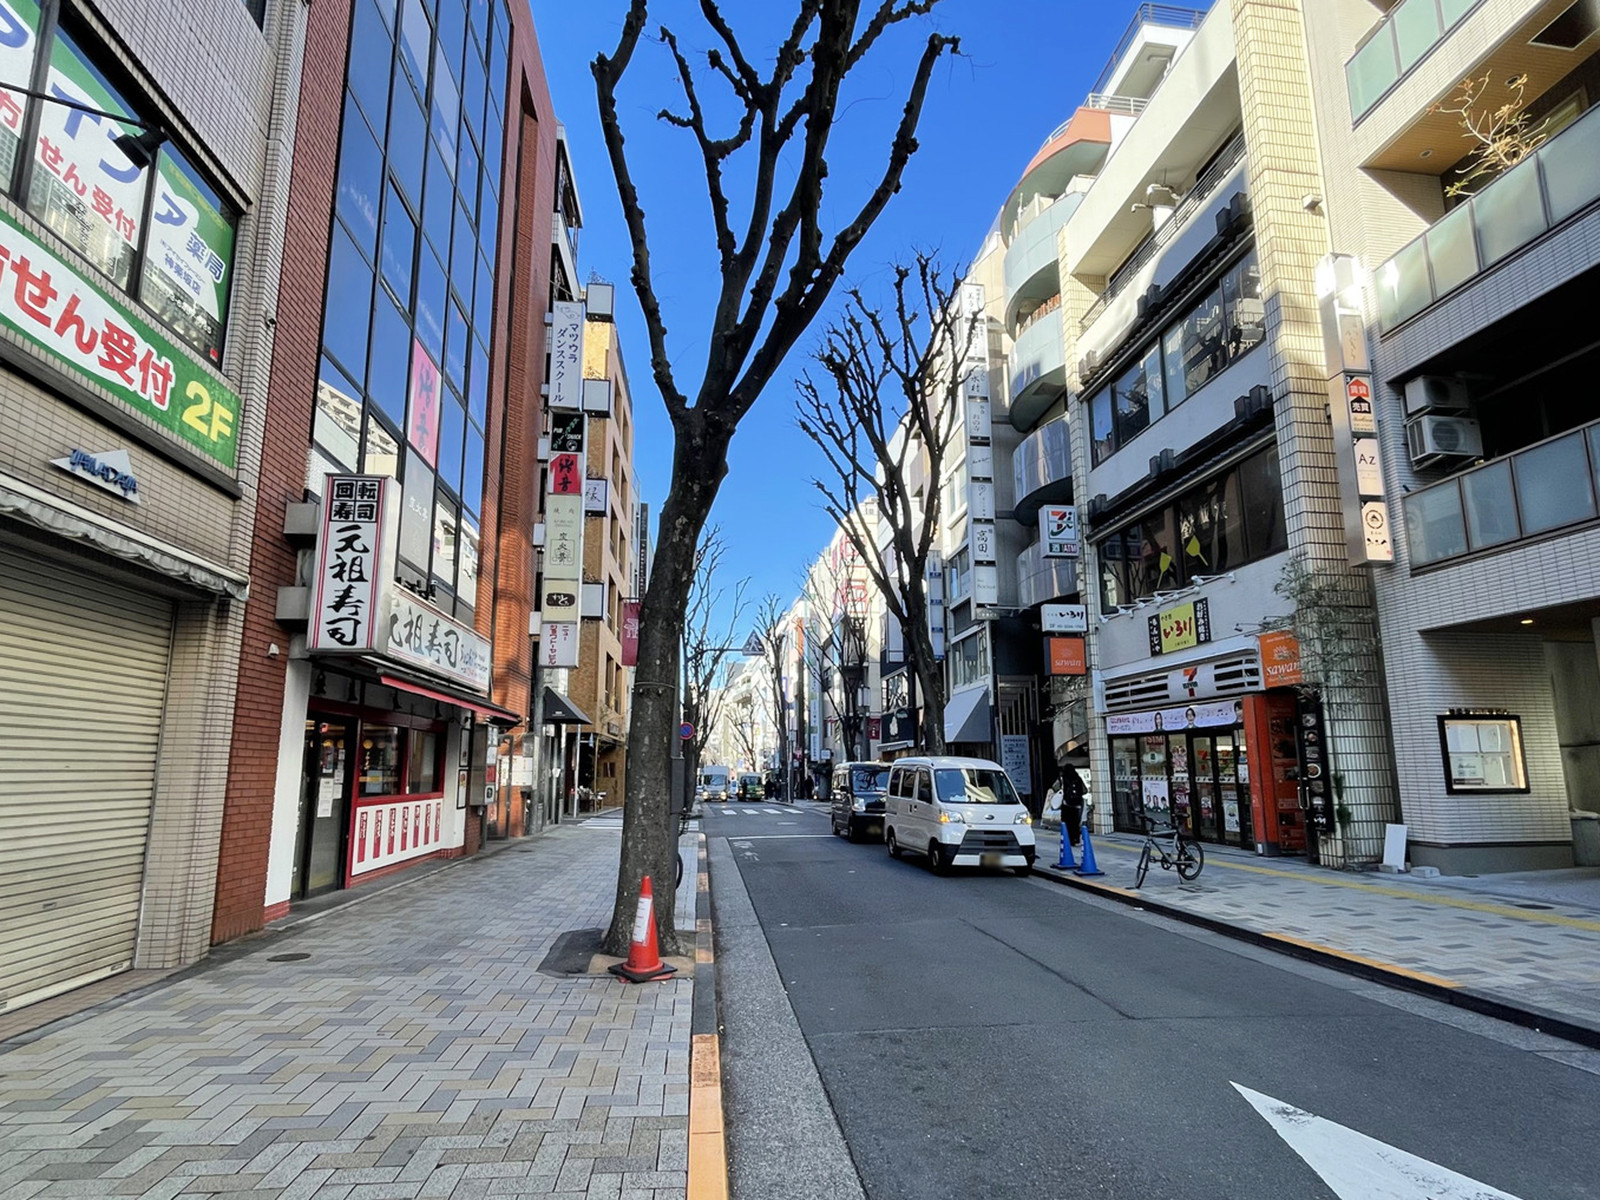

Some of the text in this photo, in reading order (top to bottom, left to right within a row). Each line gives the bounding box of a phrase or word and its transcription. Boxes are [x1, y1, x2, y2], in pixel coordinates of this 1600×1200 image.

[39, 135, 137, 242] せん受付
[0, 243, 173, 407] せん受付
[182, 380, 234, 442] 2F
[568, 323, 579, 364] マツウラ
[553, 327, 568, 402] ダンススクール
[1352, 402, 1370, 412] 売買
[1358, 453, 1376, 465] Az
[335, 482, 377, 500] 回転
[333, 502, 375, 520] 寿司
[326, 524, 370, 646] 元祖寿司
[1059, 610, 1084, 620] いろり
[1196, 602, 1205, 642] お好み焼き
[1163, 616, 1192, 639] いろり
[1054, 659, 1082, 667] sawan
[1175, 793, 1189, 805] SIM
